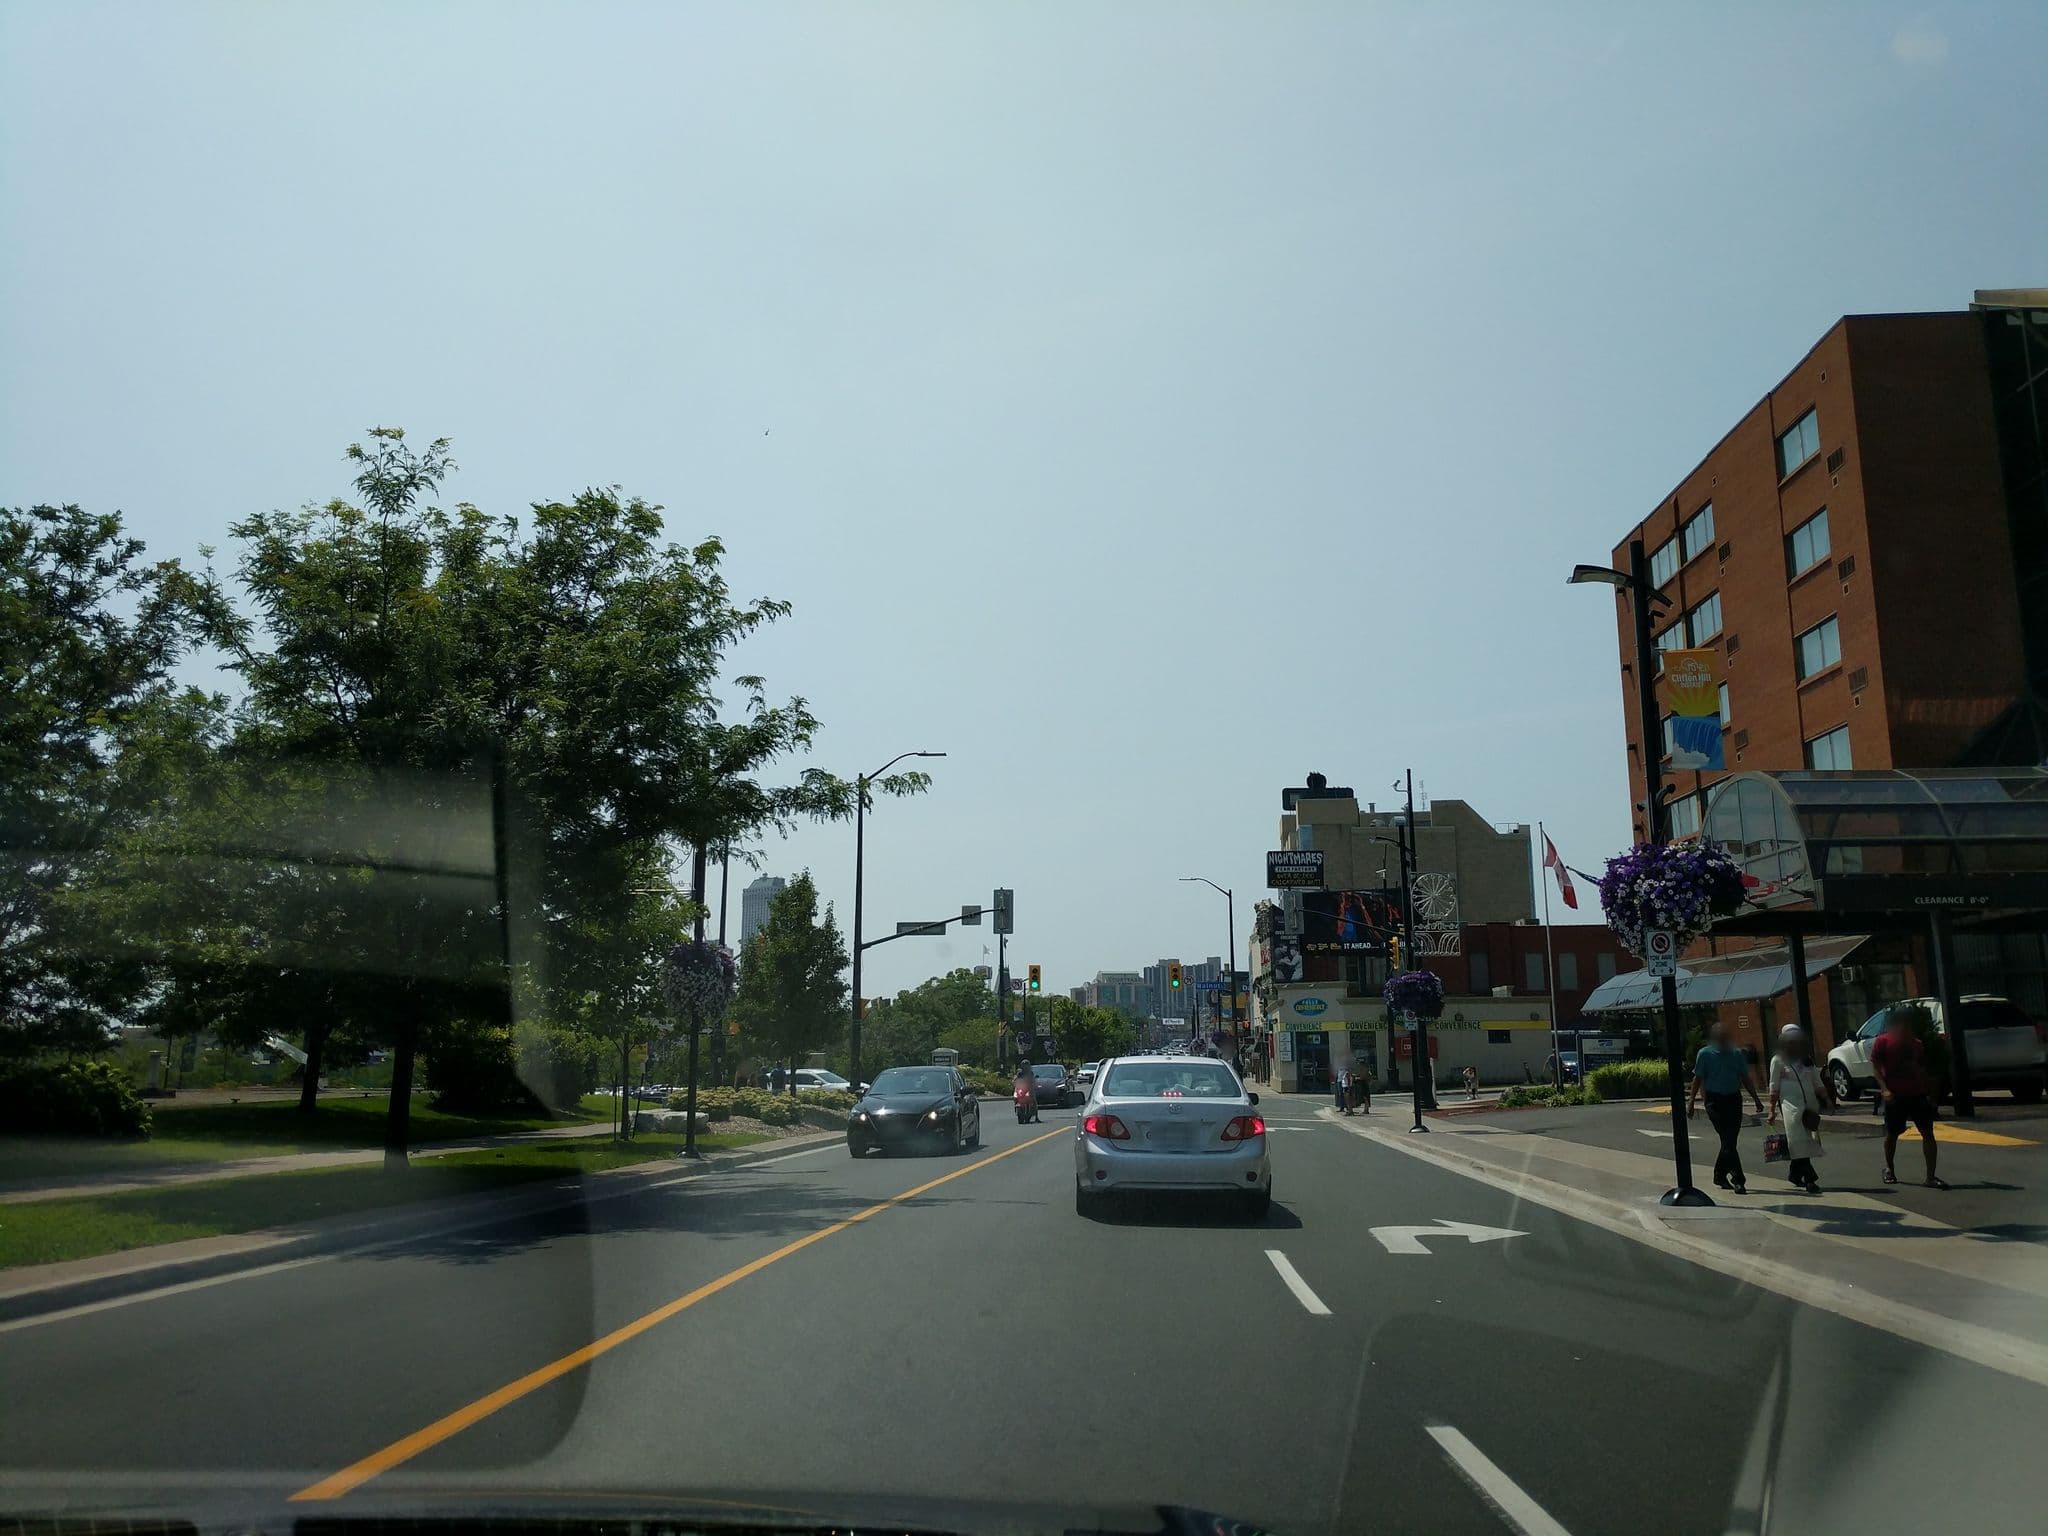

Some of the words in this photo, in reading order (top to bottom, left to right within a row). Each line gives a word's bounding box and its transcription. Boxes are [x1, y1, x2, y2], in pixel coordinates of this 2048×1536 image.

[1672, 674, 1698, 682] Clifton
[1699, 673, 1712, 682] Hill
[1268, 852, 1323, 865] NIGHTMARES
[1914, 896, 1964, 905] CLEARANCE
[1434, 1020, 1481, 1030] CONVENIENCE
